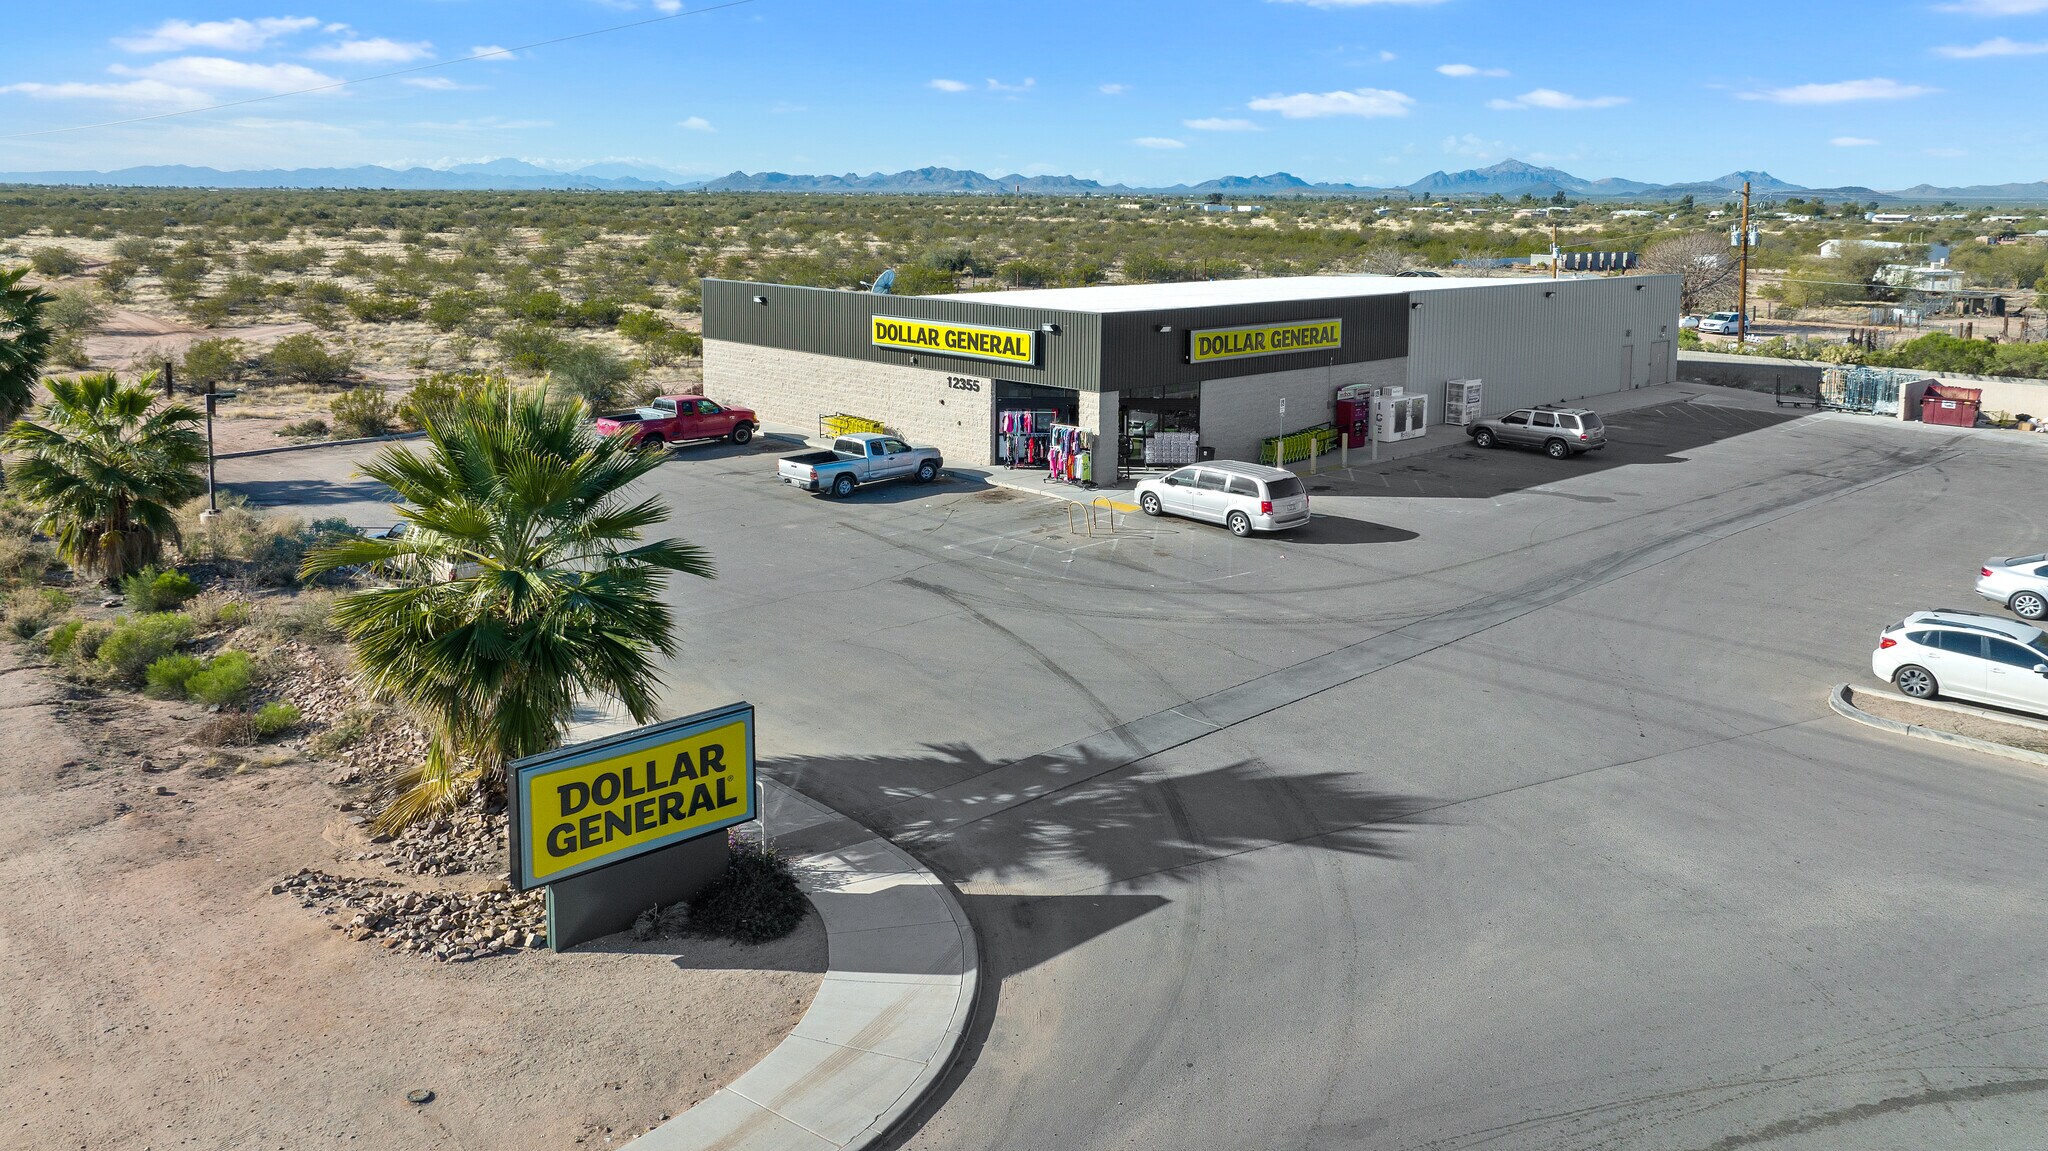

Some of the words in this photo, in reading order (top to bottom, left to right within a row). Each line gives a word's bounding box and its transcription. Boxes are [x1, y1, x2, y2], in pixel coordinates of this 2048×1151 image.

[875, 322, 940, 346] DOLLAR
[945, 330, 1026, 357] GENERAL
[1199, 332, 1266, 356] DOLLAR
[1270, 325, 1338, 348] GENERAL
[946, 376, 980, 392] 12355
[557, 743, 726, 817] DOLLAR
[546, 778, 738, 858] GENERAL
